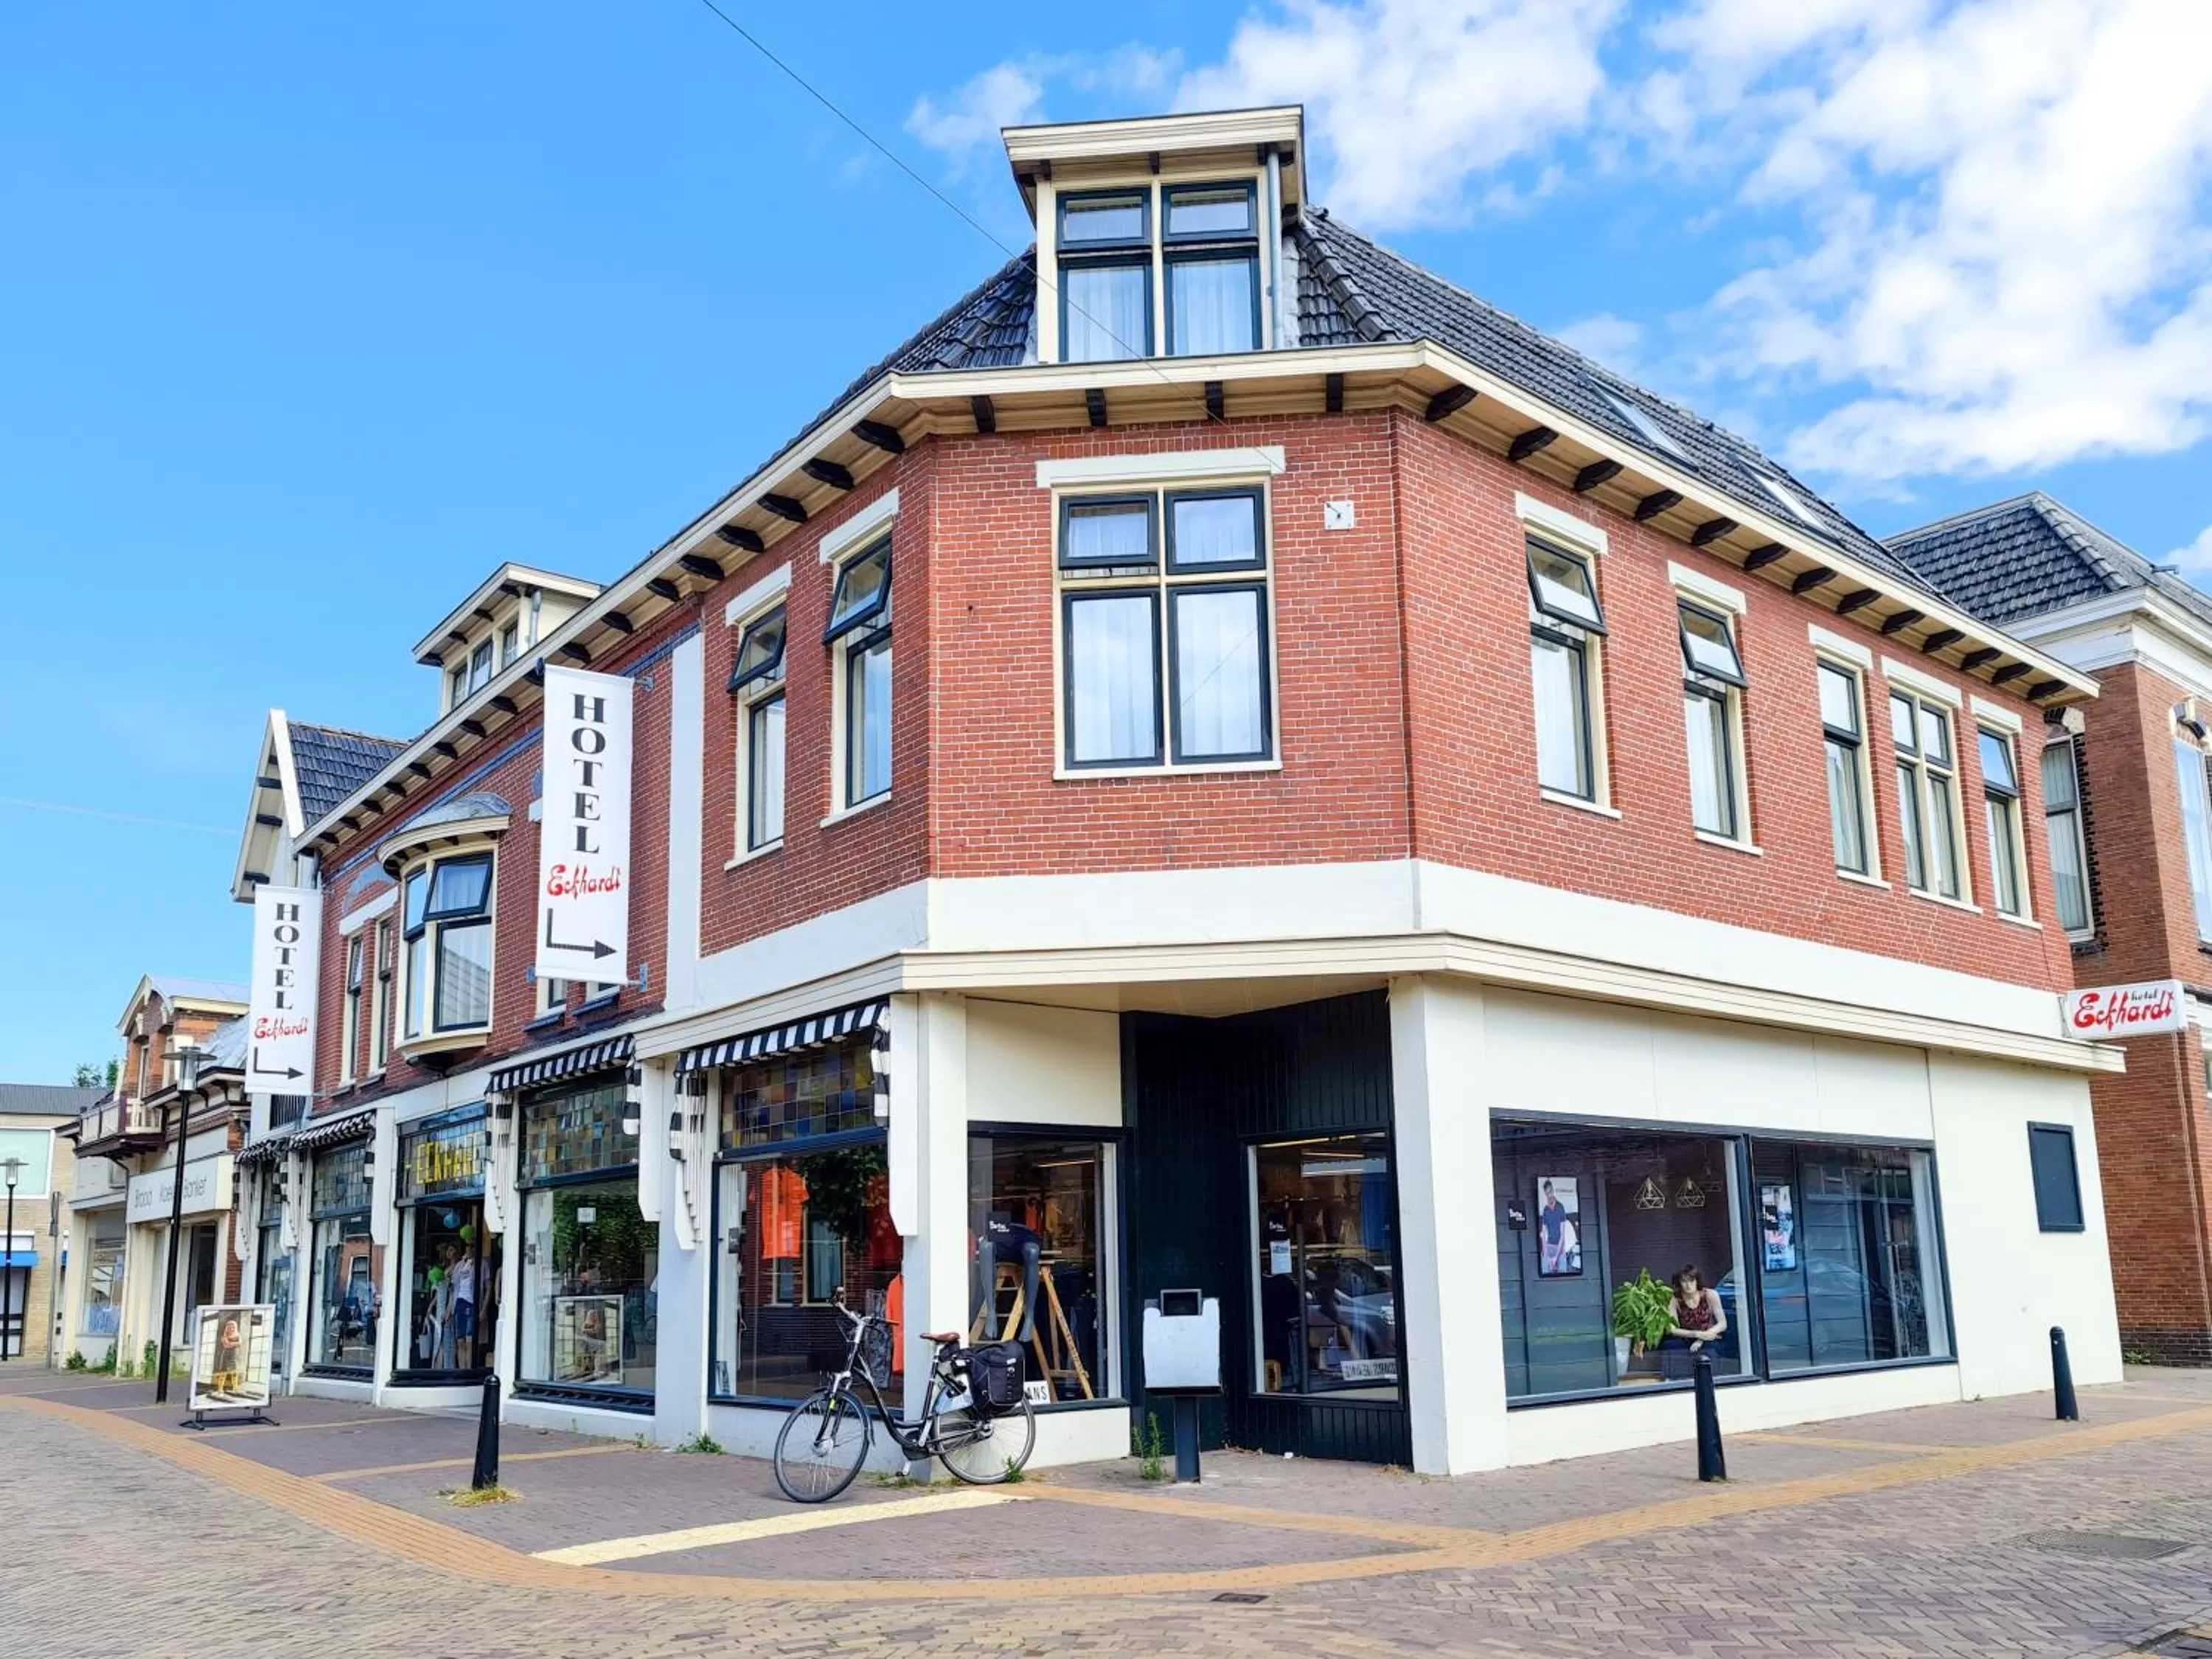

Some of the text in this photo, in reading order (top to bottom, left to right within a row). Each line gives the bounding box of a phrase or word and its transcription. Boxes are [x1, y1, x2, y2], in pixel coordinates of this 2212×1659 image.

[570, 692, 608, 855] HOTEL
[546, 863, 622, 900] Eckhardt
[274, 902, 301, 1010] HOTEL
[254, 1017, 308, 1042] Eckhardt
[2073, 991, 2174, 1032] Eckhardt
